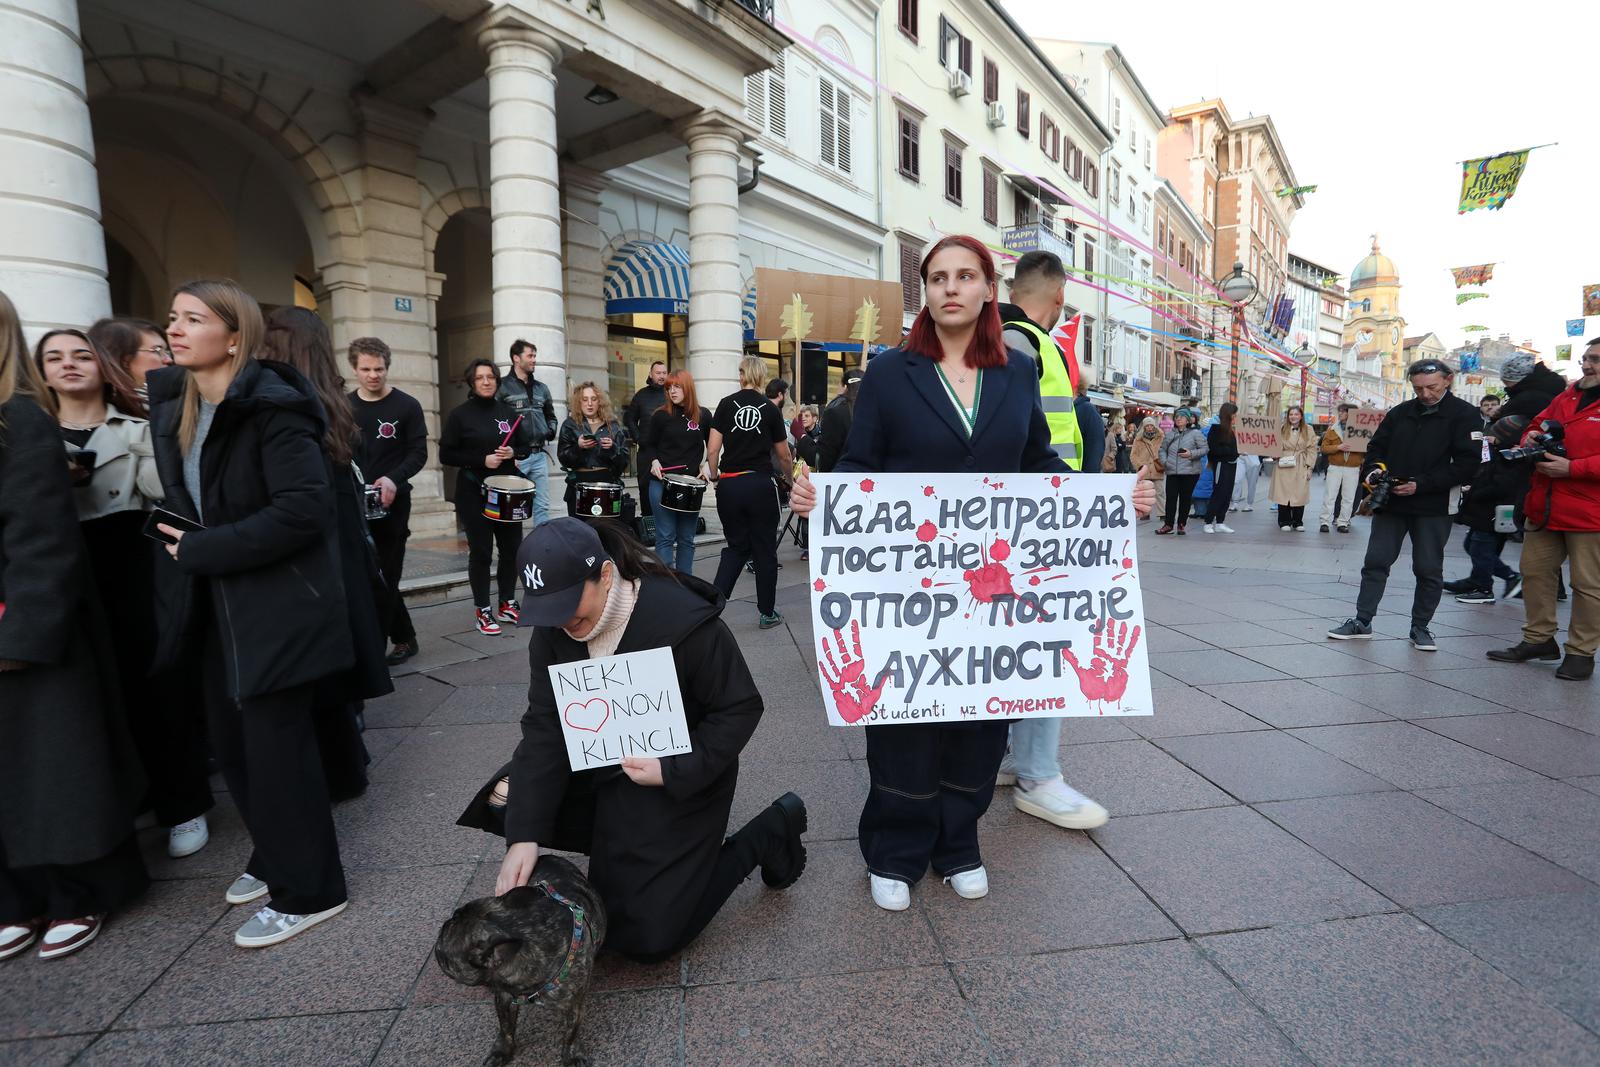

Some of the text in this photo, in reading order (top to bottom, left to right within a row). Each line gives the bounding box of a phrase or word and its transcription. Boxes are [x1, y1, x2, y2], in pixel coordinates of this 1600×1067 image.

[1007, 230, 1037, 240] HAPPY
[1005, 240, 1038, 249] HOSTEL
[1241, 417, 1275, 429] PROTIV
[1237, 432, 1278, 448] NASILJA
[821, 542, 981, 576] постане
[558, 660, 633, 696] NEKI
[612, 690, 672, 719] NOVI
[870, 700, 945, 721] Studenti
